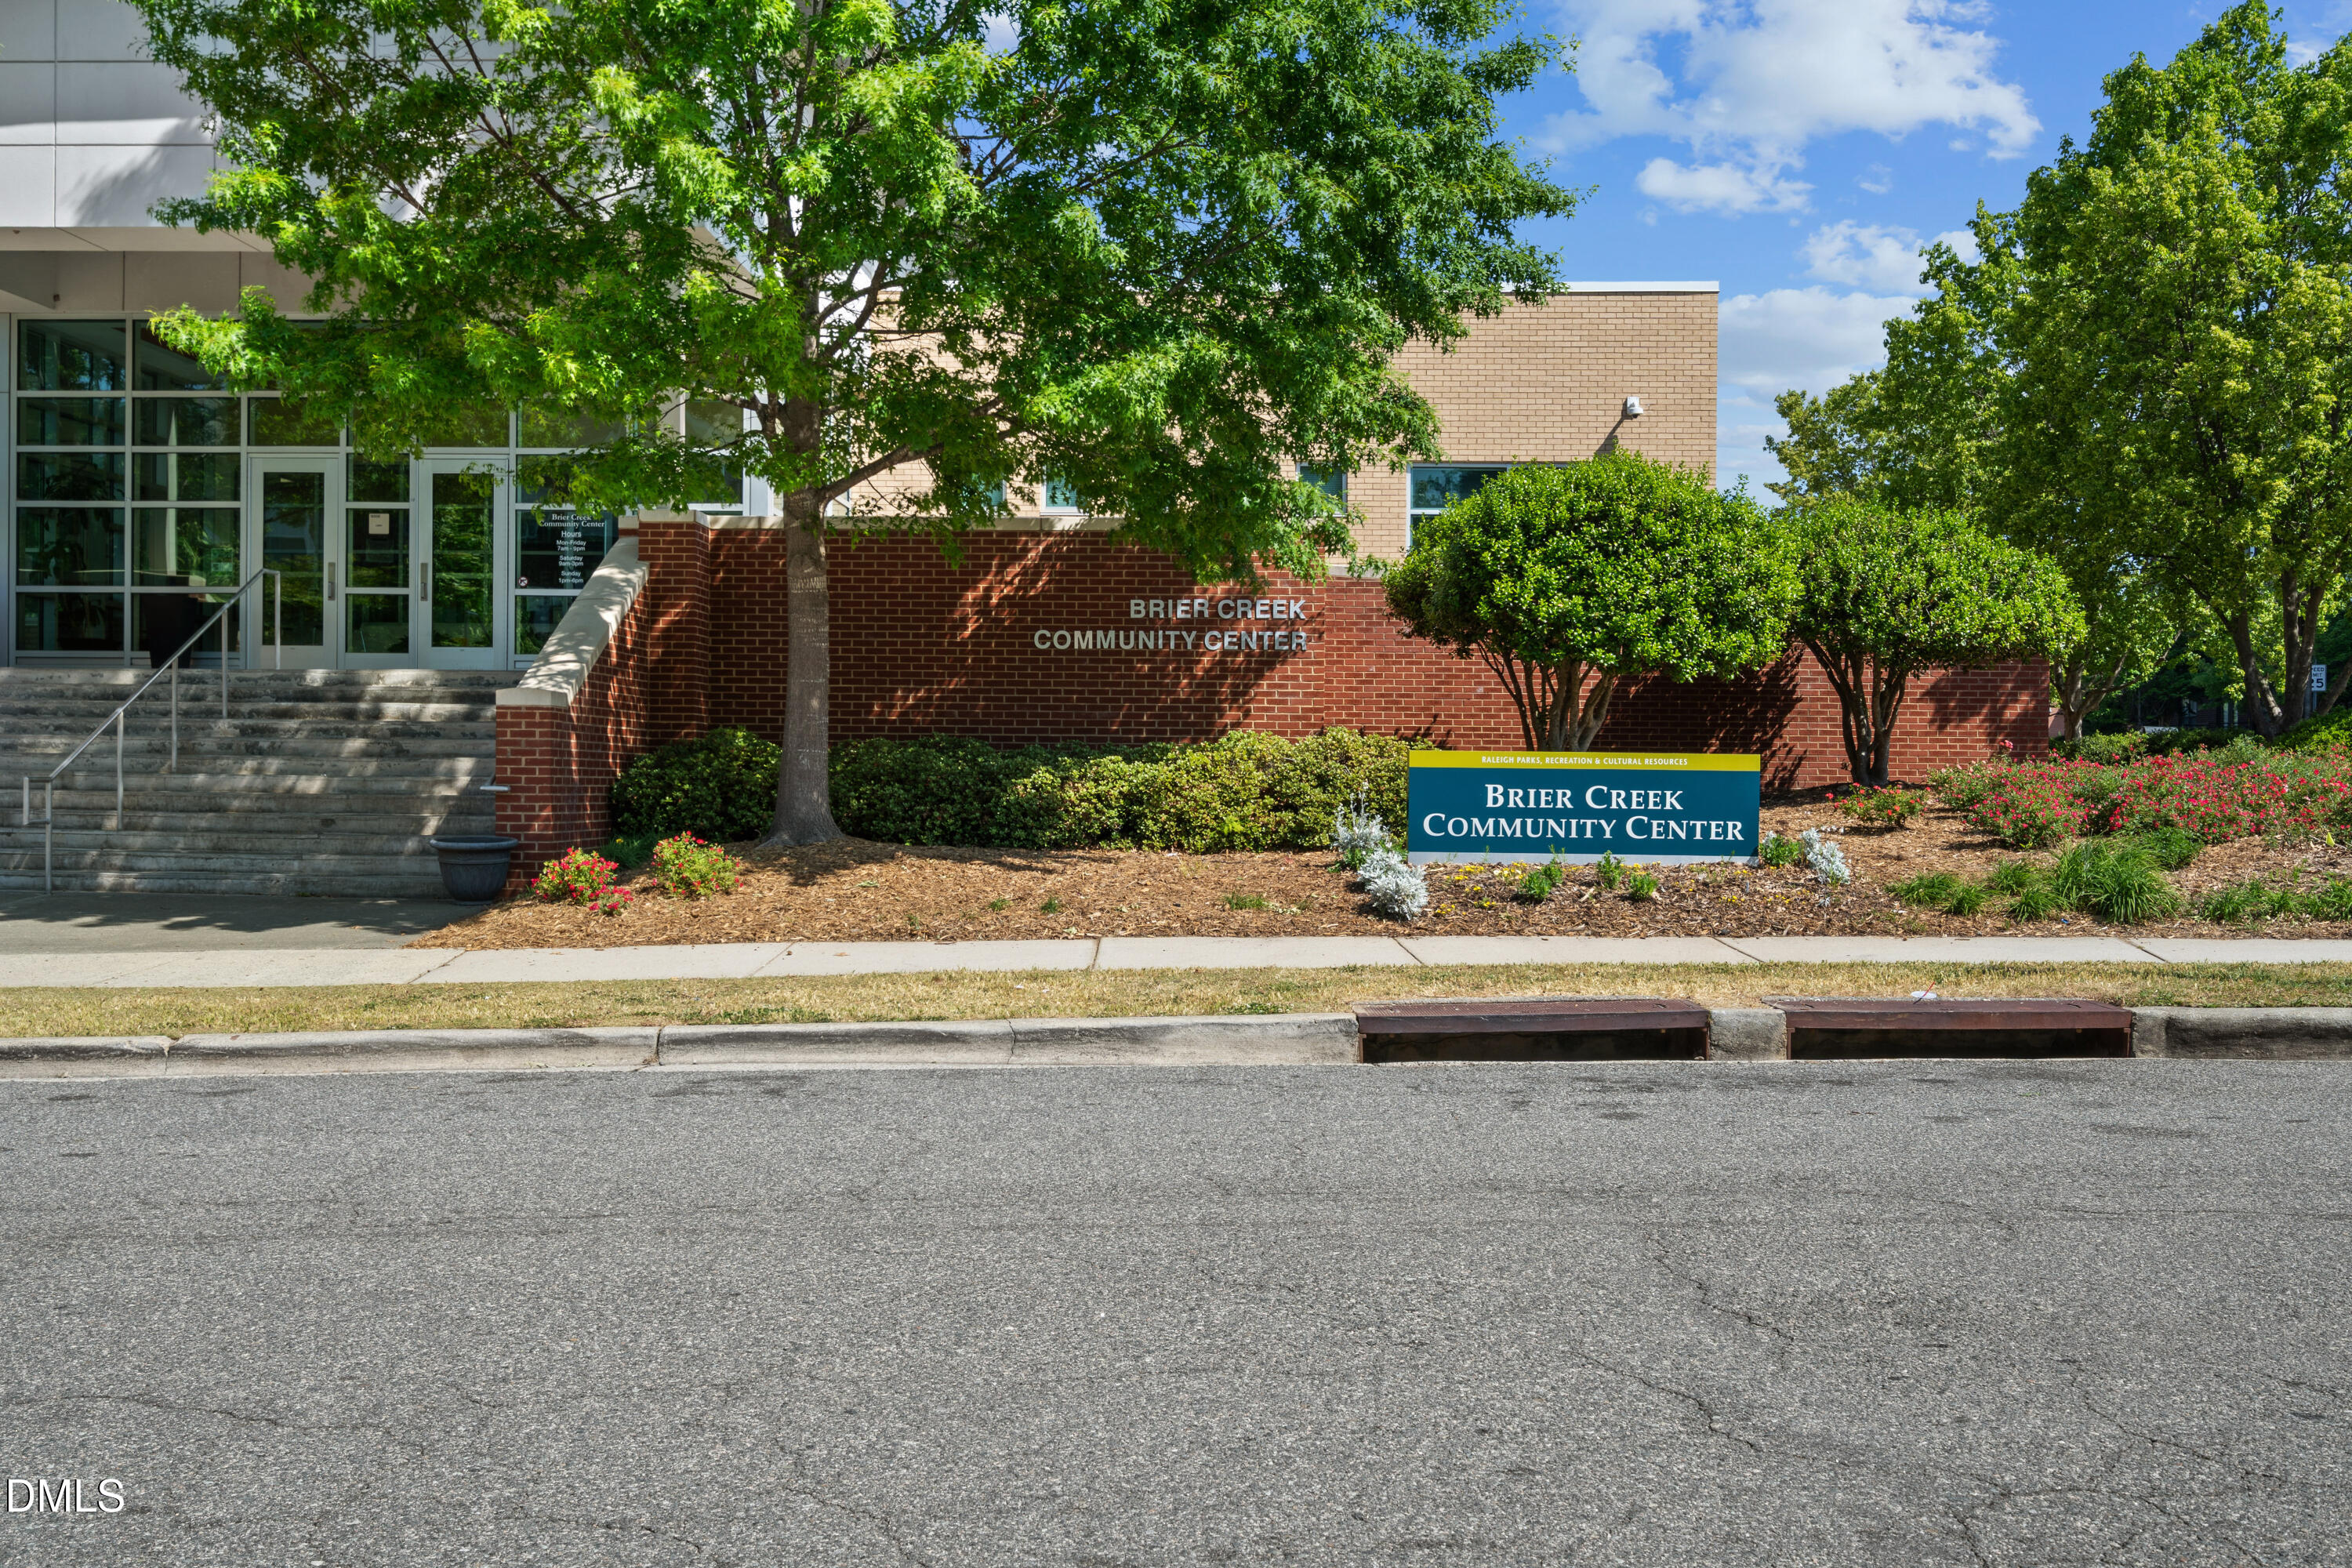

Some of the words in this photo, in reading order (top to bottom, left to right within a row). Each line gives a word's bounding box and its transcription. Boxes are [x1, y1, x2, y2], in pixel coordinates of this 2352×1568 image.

[539, 520, 579, 528] Community
[1130, 599, 1210, 619] BRIER
[1217, 599, 1307, 619] CREEK
[1033, 630, 1197, 650] COMMUNITY
[1203, 630, 1307, 651] CENTER
[1516, 757, 1542, 765] PARKS,
